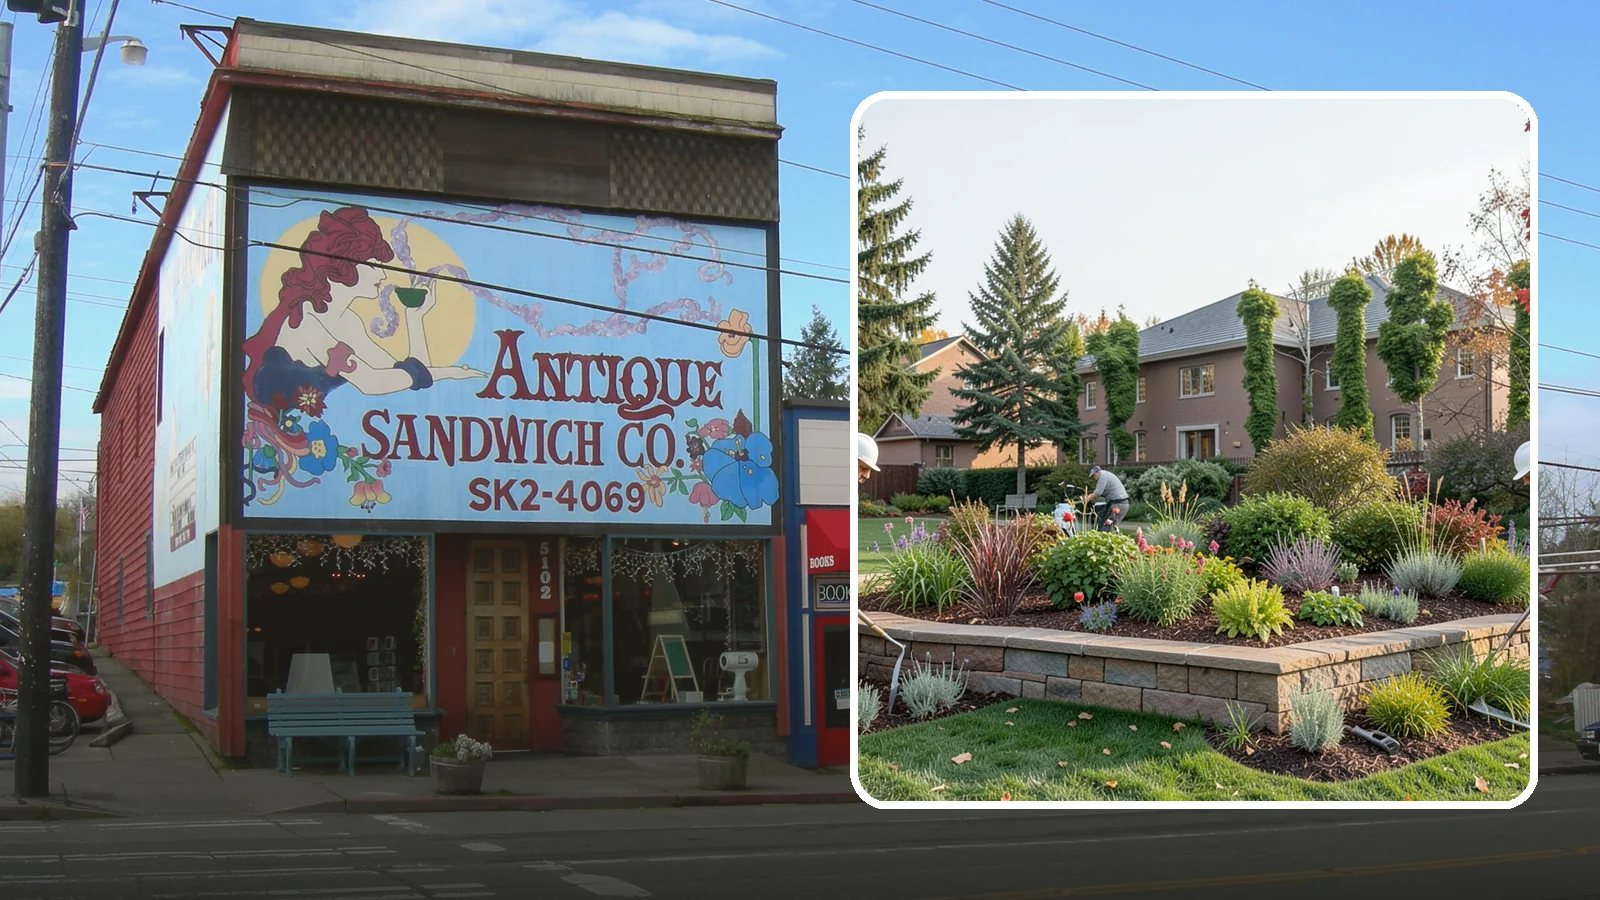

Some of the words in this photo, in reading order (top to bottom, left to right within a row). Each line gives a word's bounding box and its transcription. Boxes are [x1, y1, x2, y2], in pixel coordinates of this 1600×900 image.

[476, 329, 723, 420] ANTIQUE
[362, 409, 604, 467] SANDWICH
[617, 422, 685, 468] CO.
[468, 477, 645, 513] SK2-4069
[540, 542, 551, 600] 5102
[809, 555, 835, 569] BOOKS
